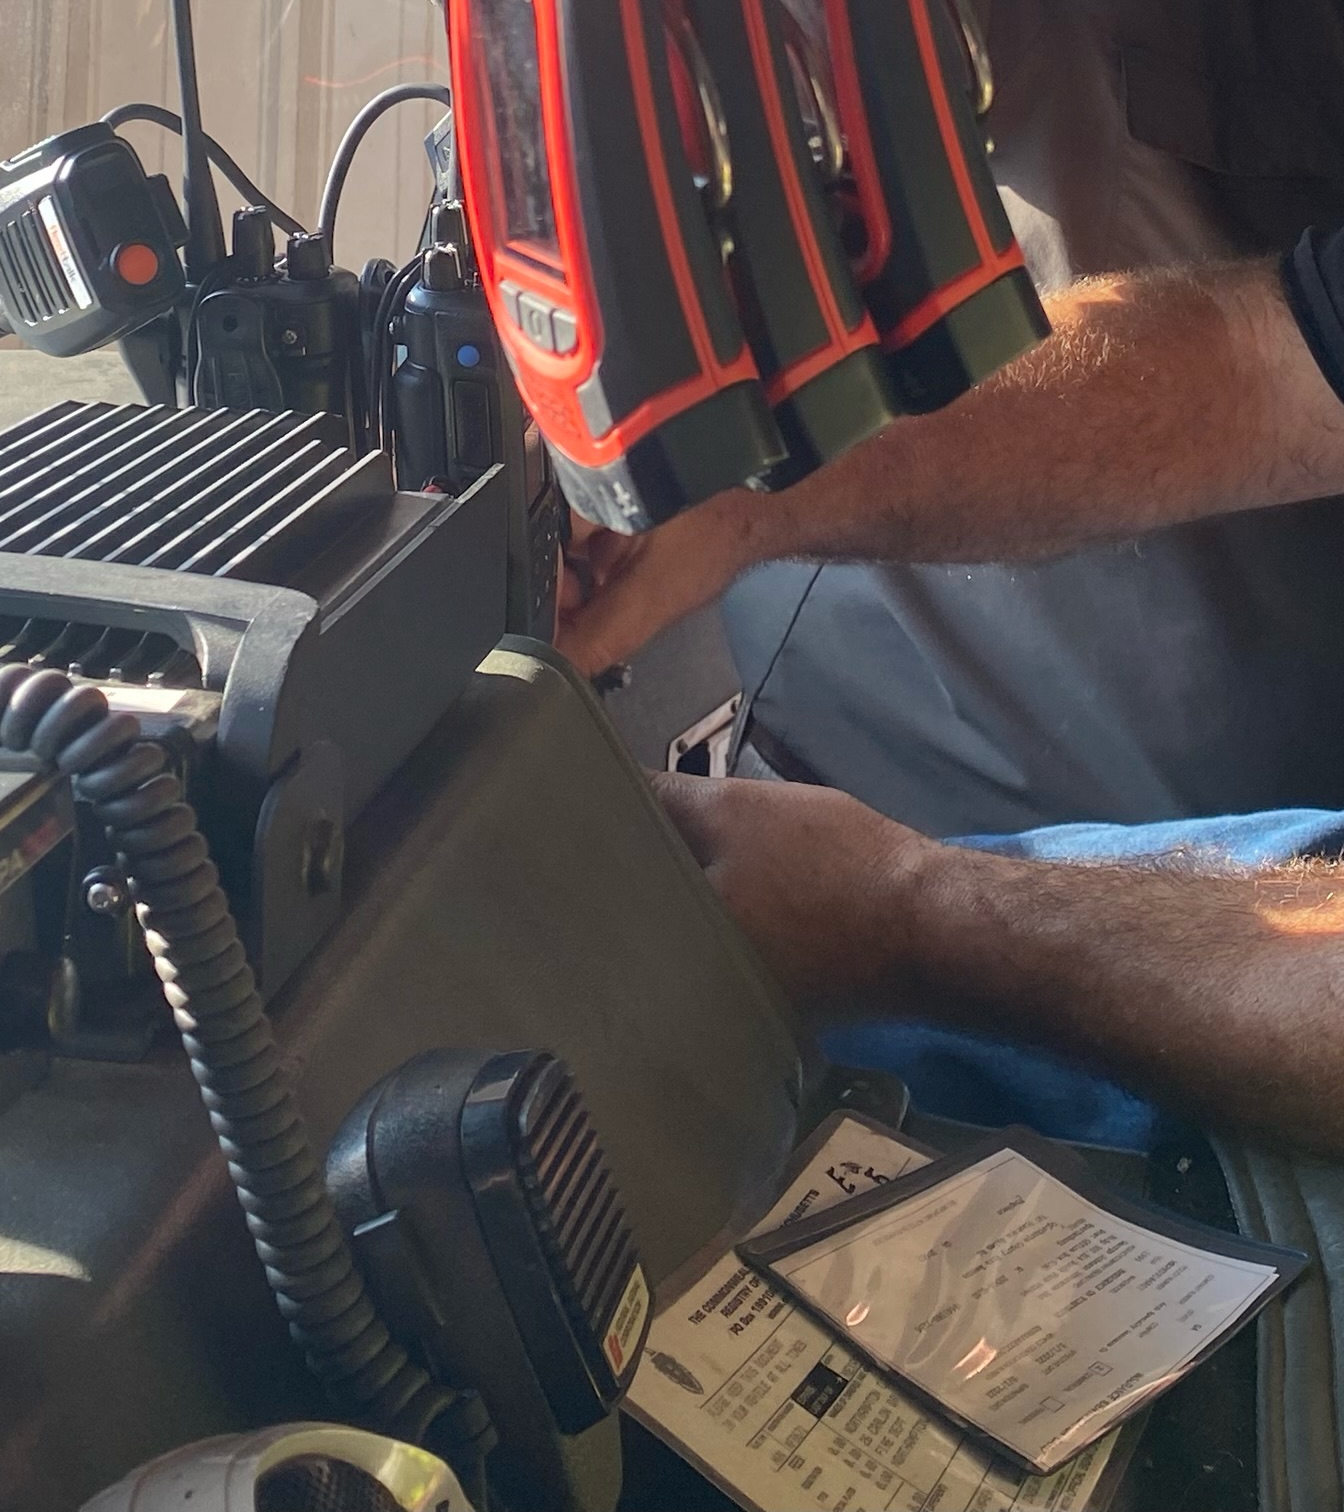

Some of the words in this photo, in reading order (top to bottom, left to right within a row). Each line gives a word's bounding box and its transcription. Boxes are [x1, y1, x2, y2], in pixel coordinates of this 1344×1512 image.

[687, 1308, 706, 1327] THE
[700, 1260, 753, 1315] COMMONWEAL
[720, 1284, 753, 1319] REGISTRY
